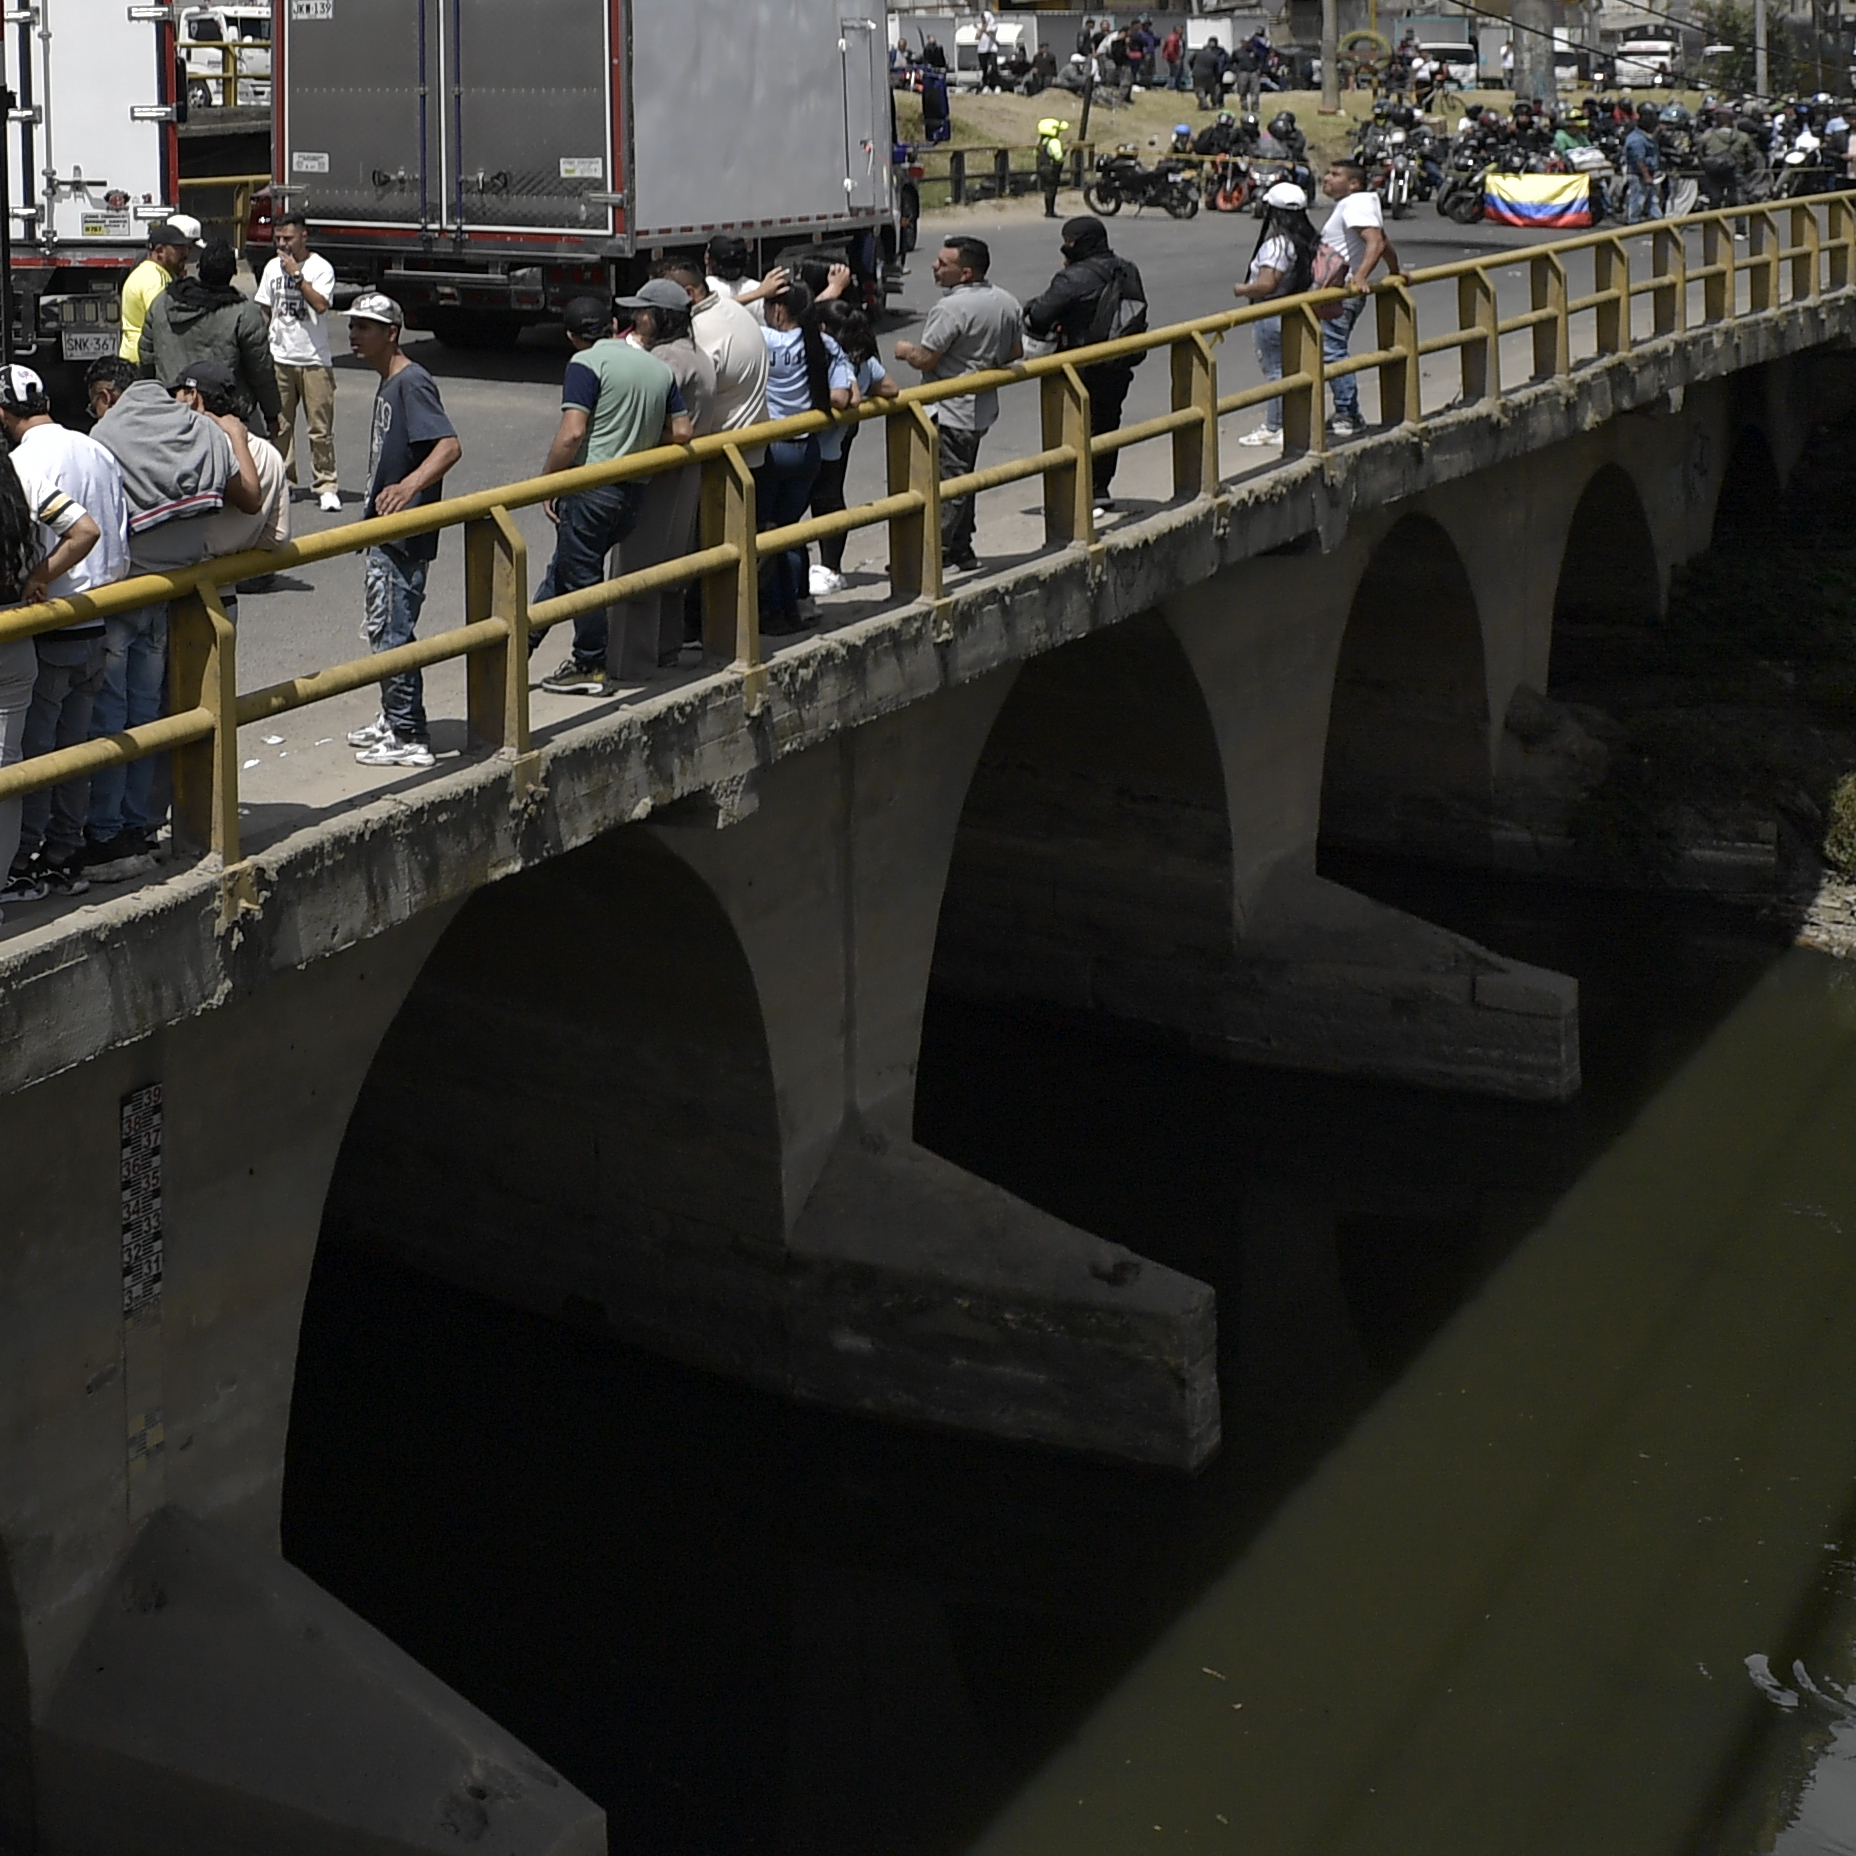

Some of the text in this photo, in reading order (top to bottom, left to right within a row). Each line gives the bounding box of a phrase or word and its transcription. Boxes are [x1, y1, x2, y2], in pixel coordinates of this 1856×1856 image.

[125, 1116, 141, 1135] 38
[144, 1128, 161, 1148] 37
[123, 1158, 140, 1178] 36
[142, 1170, 159, 1190] 35
[123, 1200, 140, 1221] 34
[144, 1213, 161, 1233] 33
[124, 1244, 141, 1265] 32
[144, 1255, 160, 1276] 31
